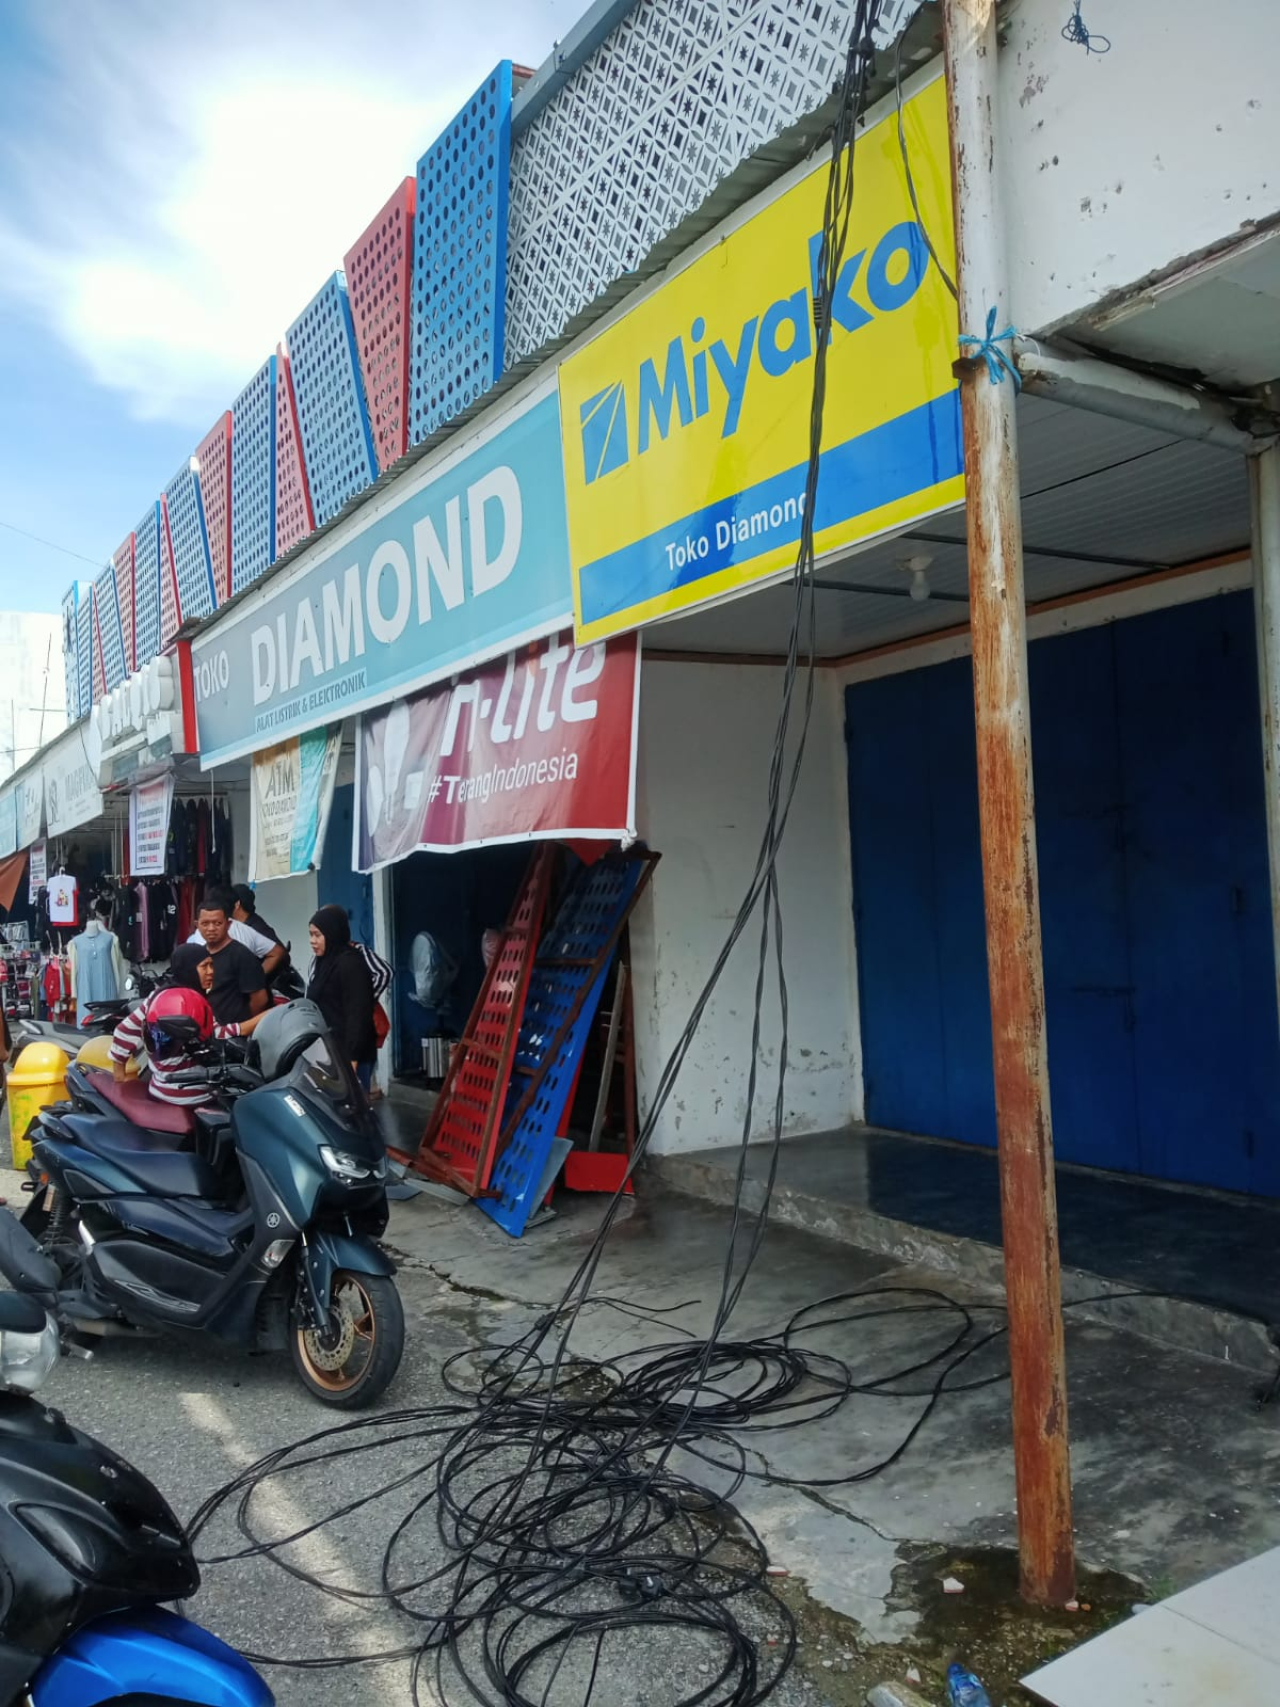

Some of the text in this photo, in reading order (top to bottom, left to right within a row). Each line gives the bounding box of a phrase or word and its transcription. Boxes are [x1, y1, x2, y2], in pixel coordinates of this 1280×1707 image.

[638, 221, 930, 456] Miyako
[665, 534, 709, 571] Toko
[193, 465, 523, 706] TOKO DIAMOND
[256, 715, 275, 733] ALAT
[275, 700, 301, 726] LISTRIK
[309, 672, 366, 710] ELEKTRONIK
[265, 758, 295, 799] ATM
[427, 747, 578, 804] #TerangIndonesia
